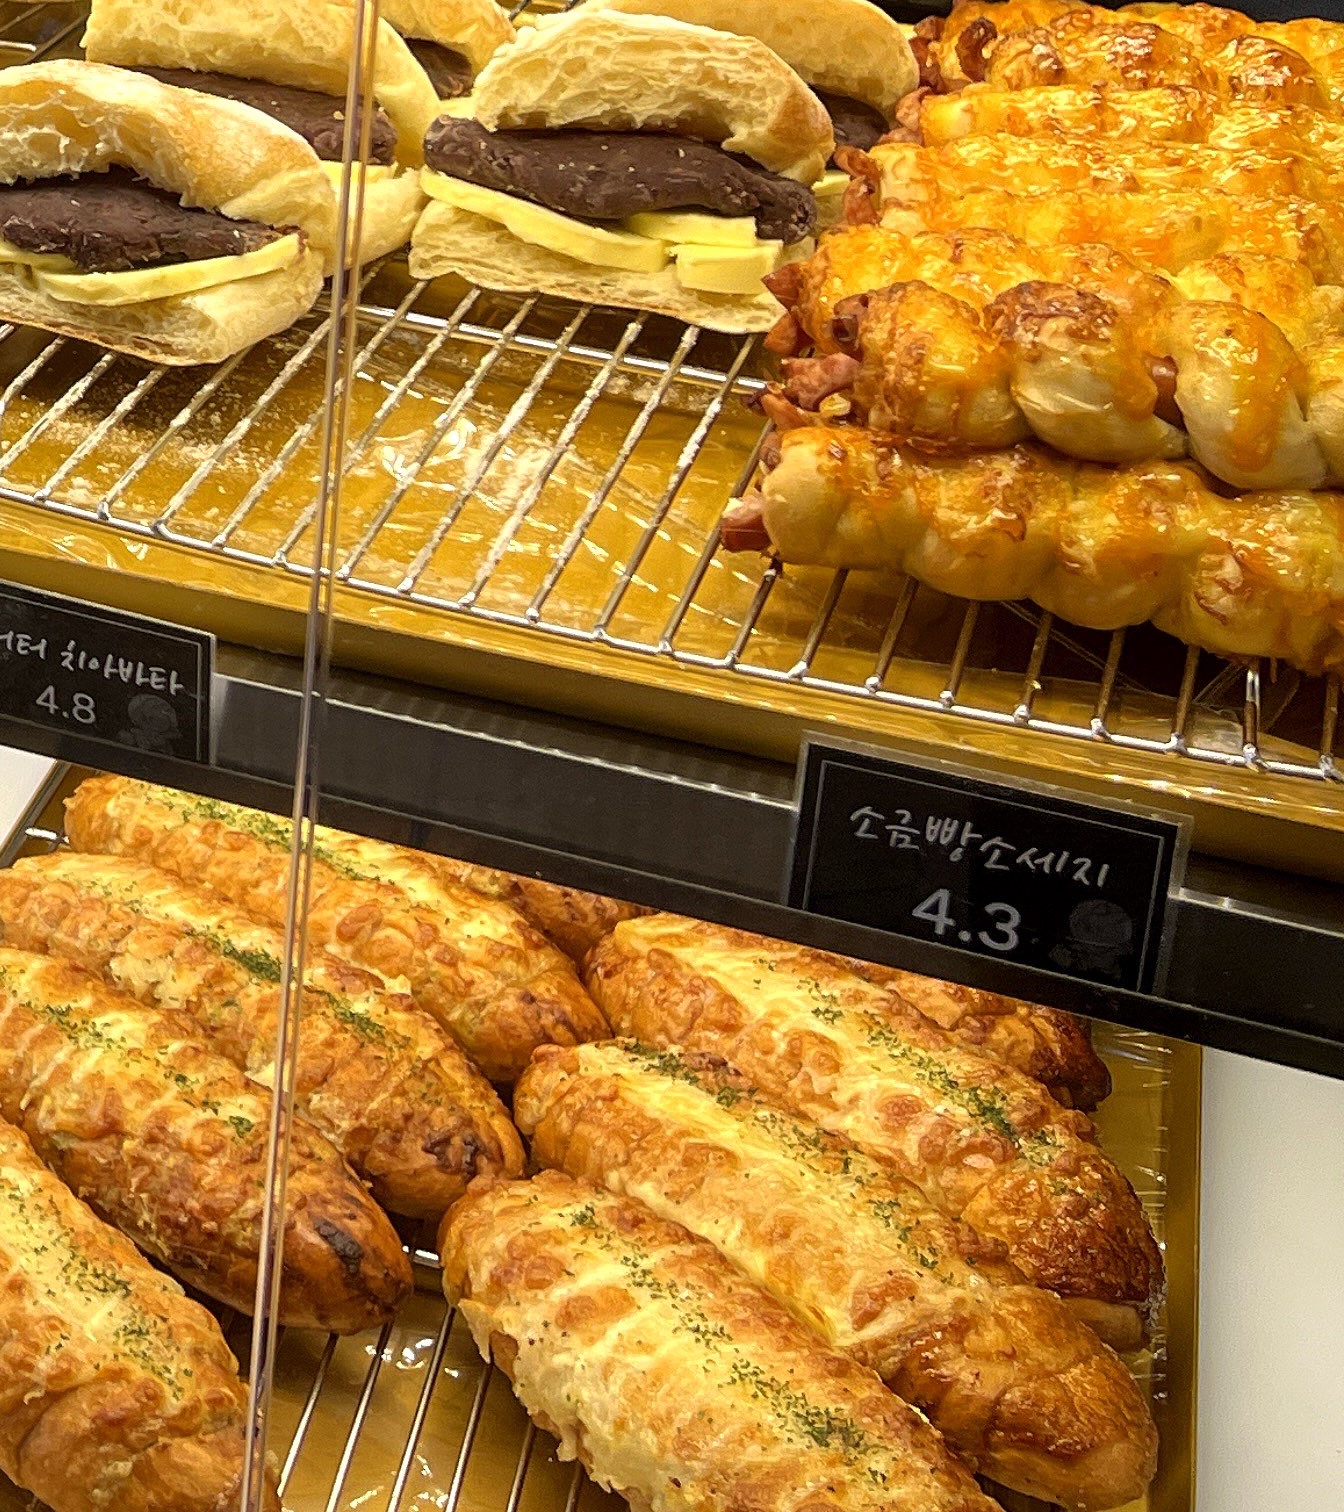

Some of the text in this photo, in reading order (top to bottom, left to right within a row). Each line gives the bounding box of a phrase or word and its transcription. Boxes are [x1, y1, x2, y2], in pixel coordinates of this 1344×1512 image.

[60, 639, 186, 695] 치아바타
[35, 684, 97, 725] 4.8
[911, 888, 1021, 952] 4.3
